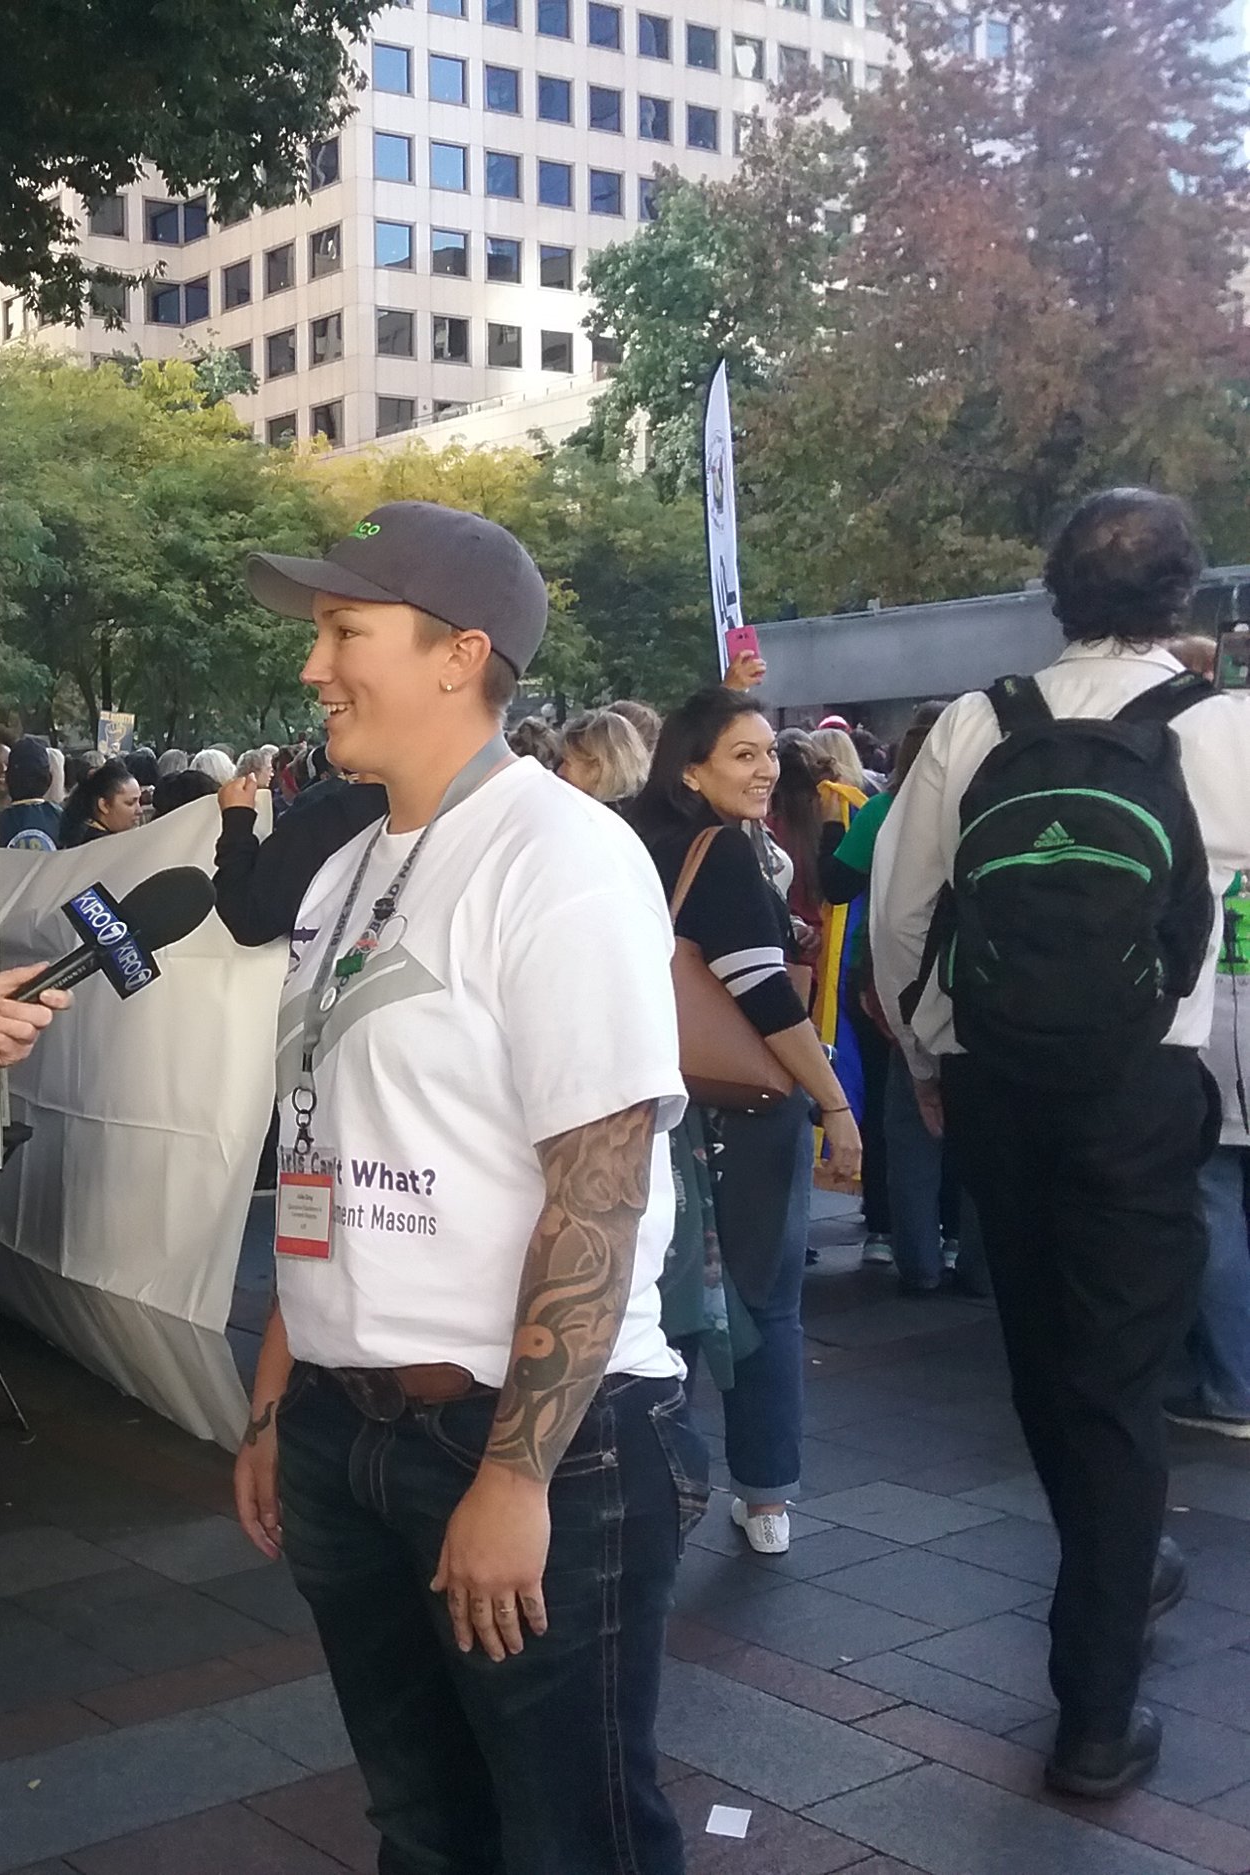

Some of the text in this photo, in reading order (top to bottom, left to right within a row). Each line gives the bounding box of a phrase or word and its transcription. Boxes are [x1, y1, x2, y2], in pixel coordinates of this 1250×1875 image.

[1033, 838, 1075, 848] adidas
[75, 891, 112, 928] KIRO
[115, 940, 142, 976] KIRO
[350, 1159, 436, 1196] What?
[371, 1203, 437, 1235] Masons
